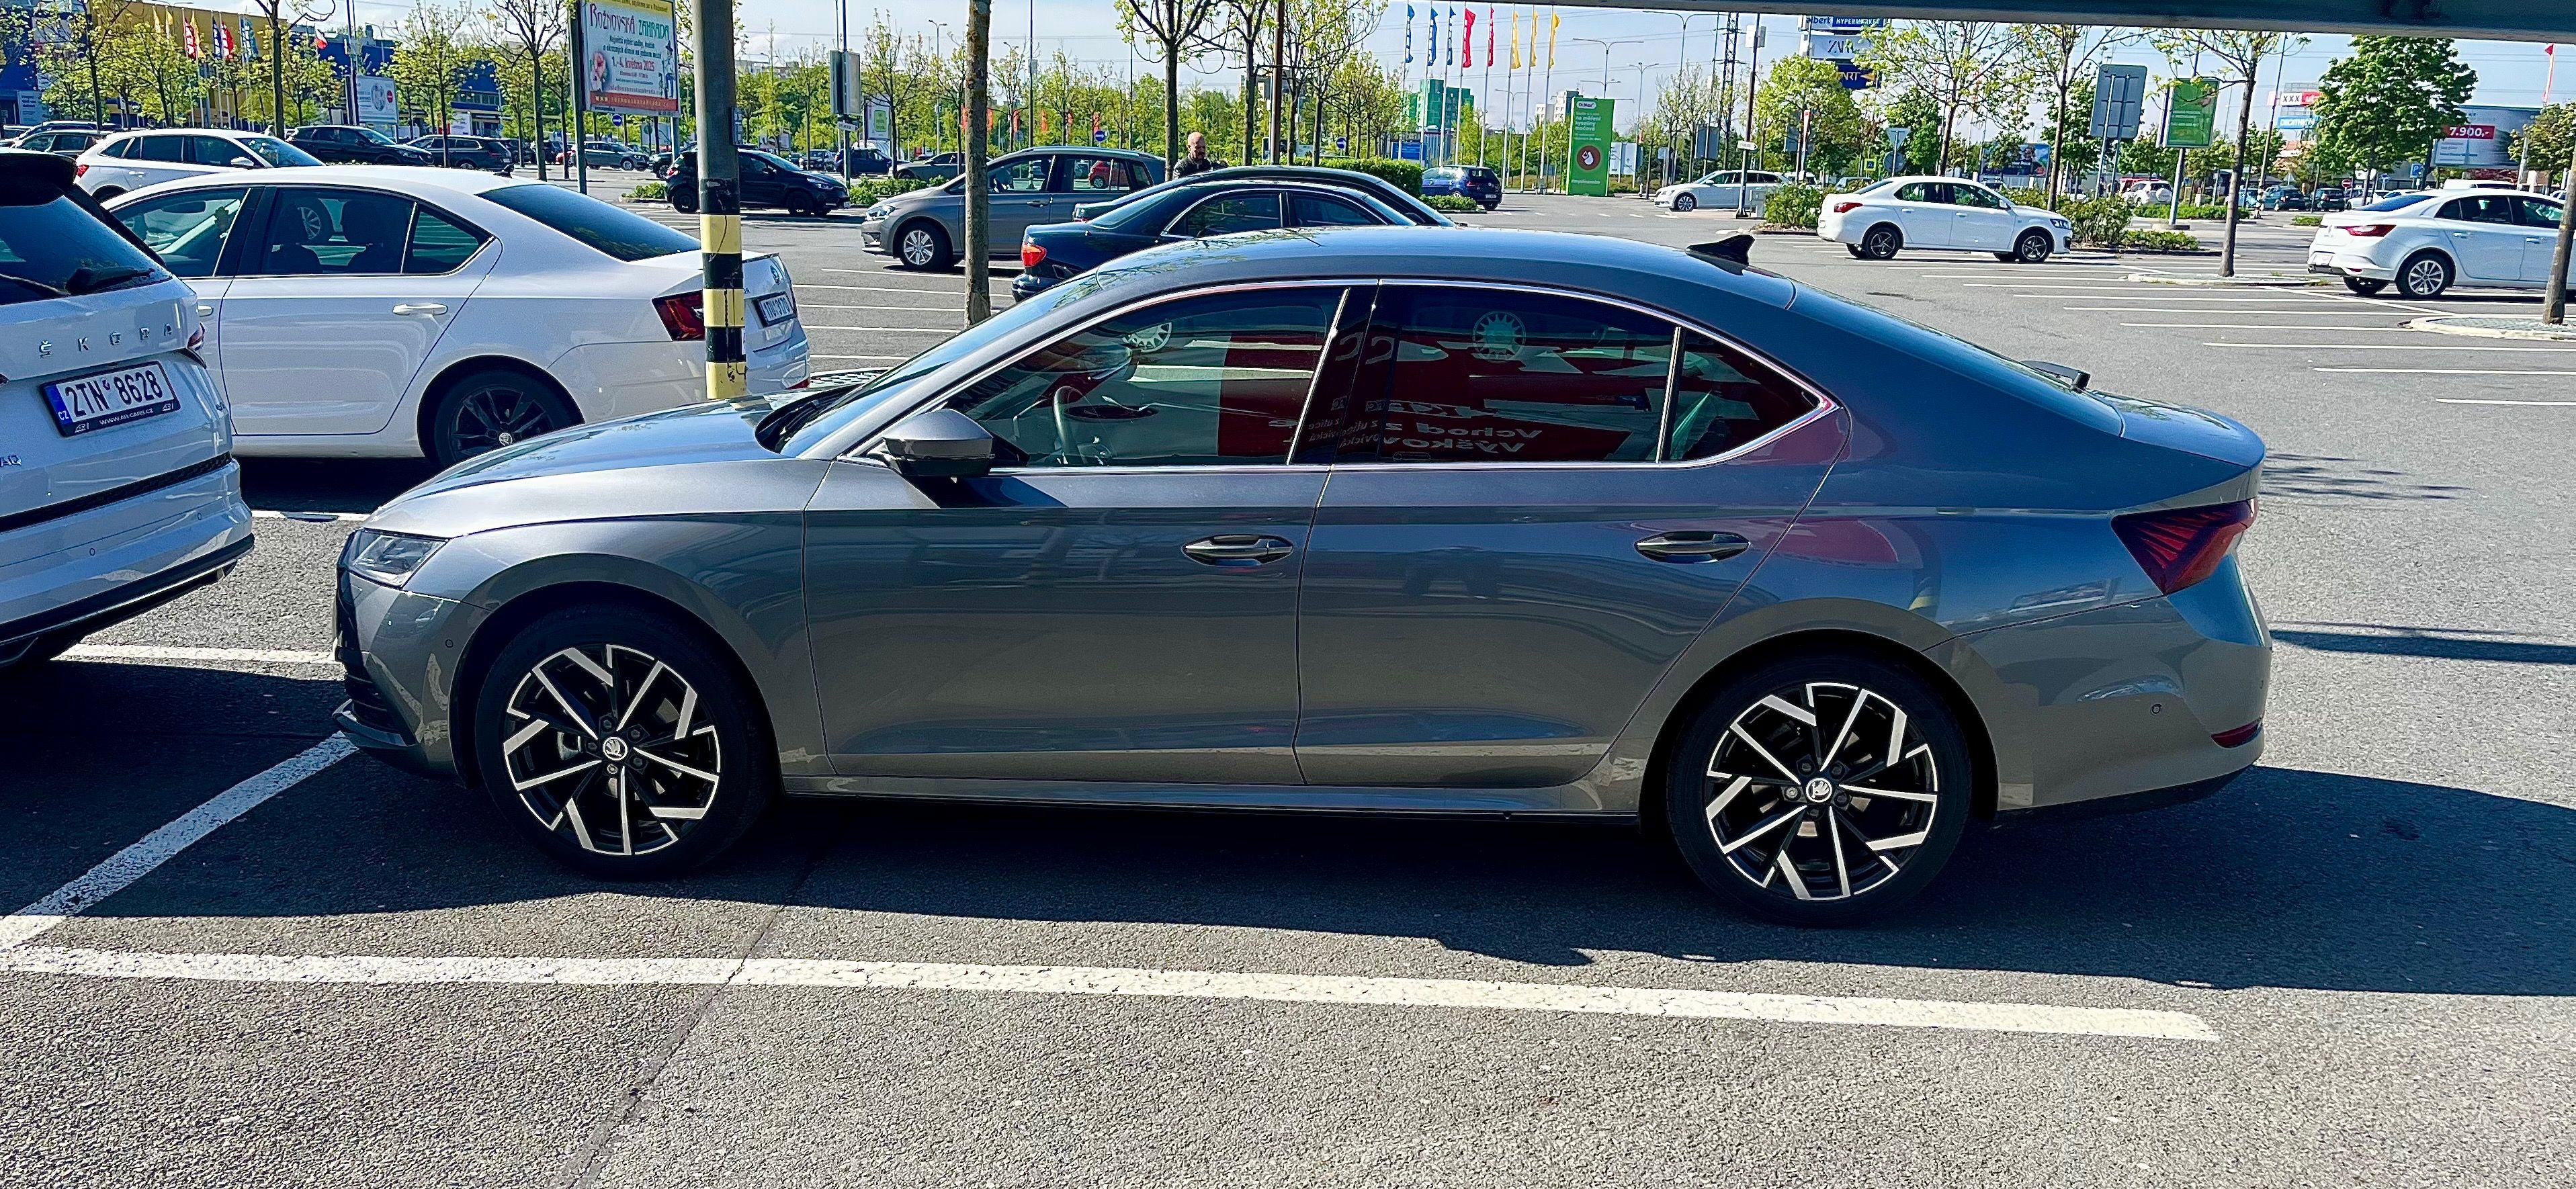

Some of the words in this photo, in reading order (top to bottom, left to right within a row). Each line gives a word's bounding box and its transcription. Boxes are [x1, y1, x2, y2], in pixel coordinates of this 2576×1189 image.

[638, 19, 670, 40] ZAHRADA
[40, 322, 173, 359] ŠKODA
[65, 380, 111, 418] 2TN
[114, 370, 163, 406] 8628
[58, 410, 69, 421] CZ
